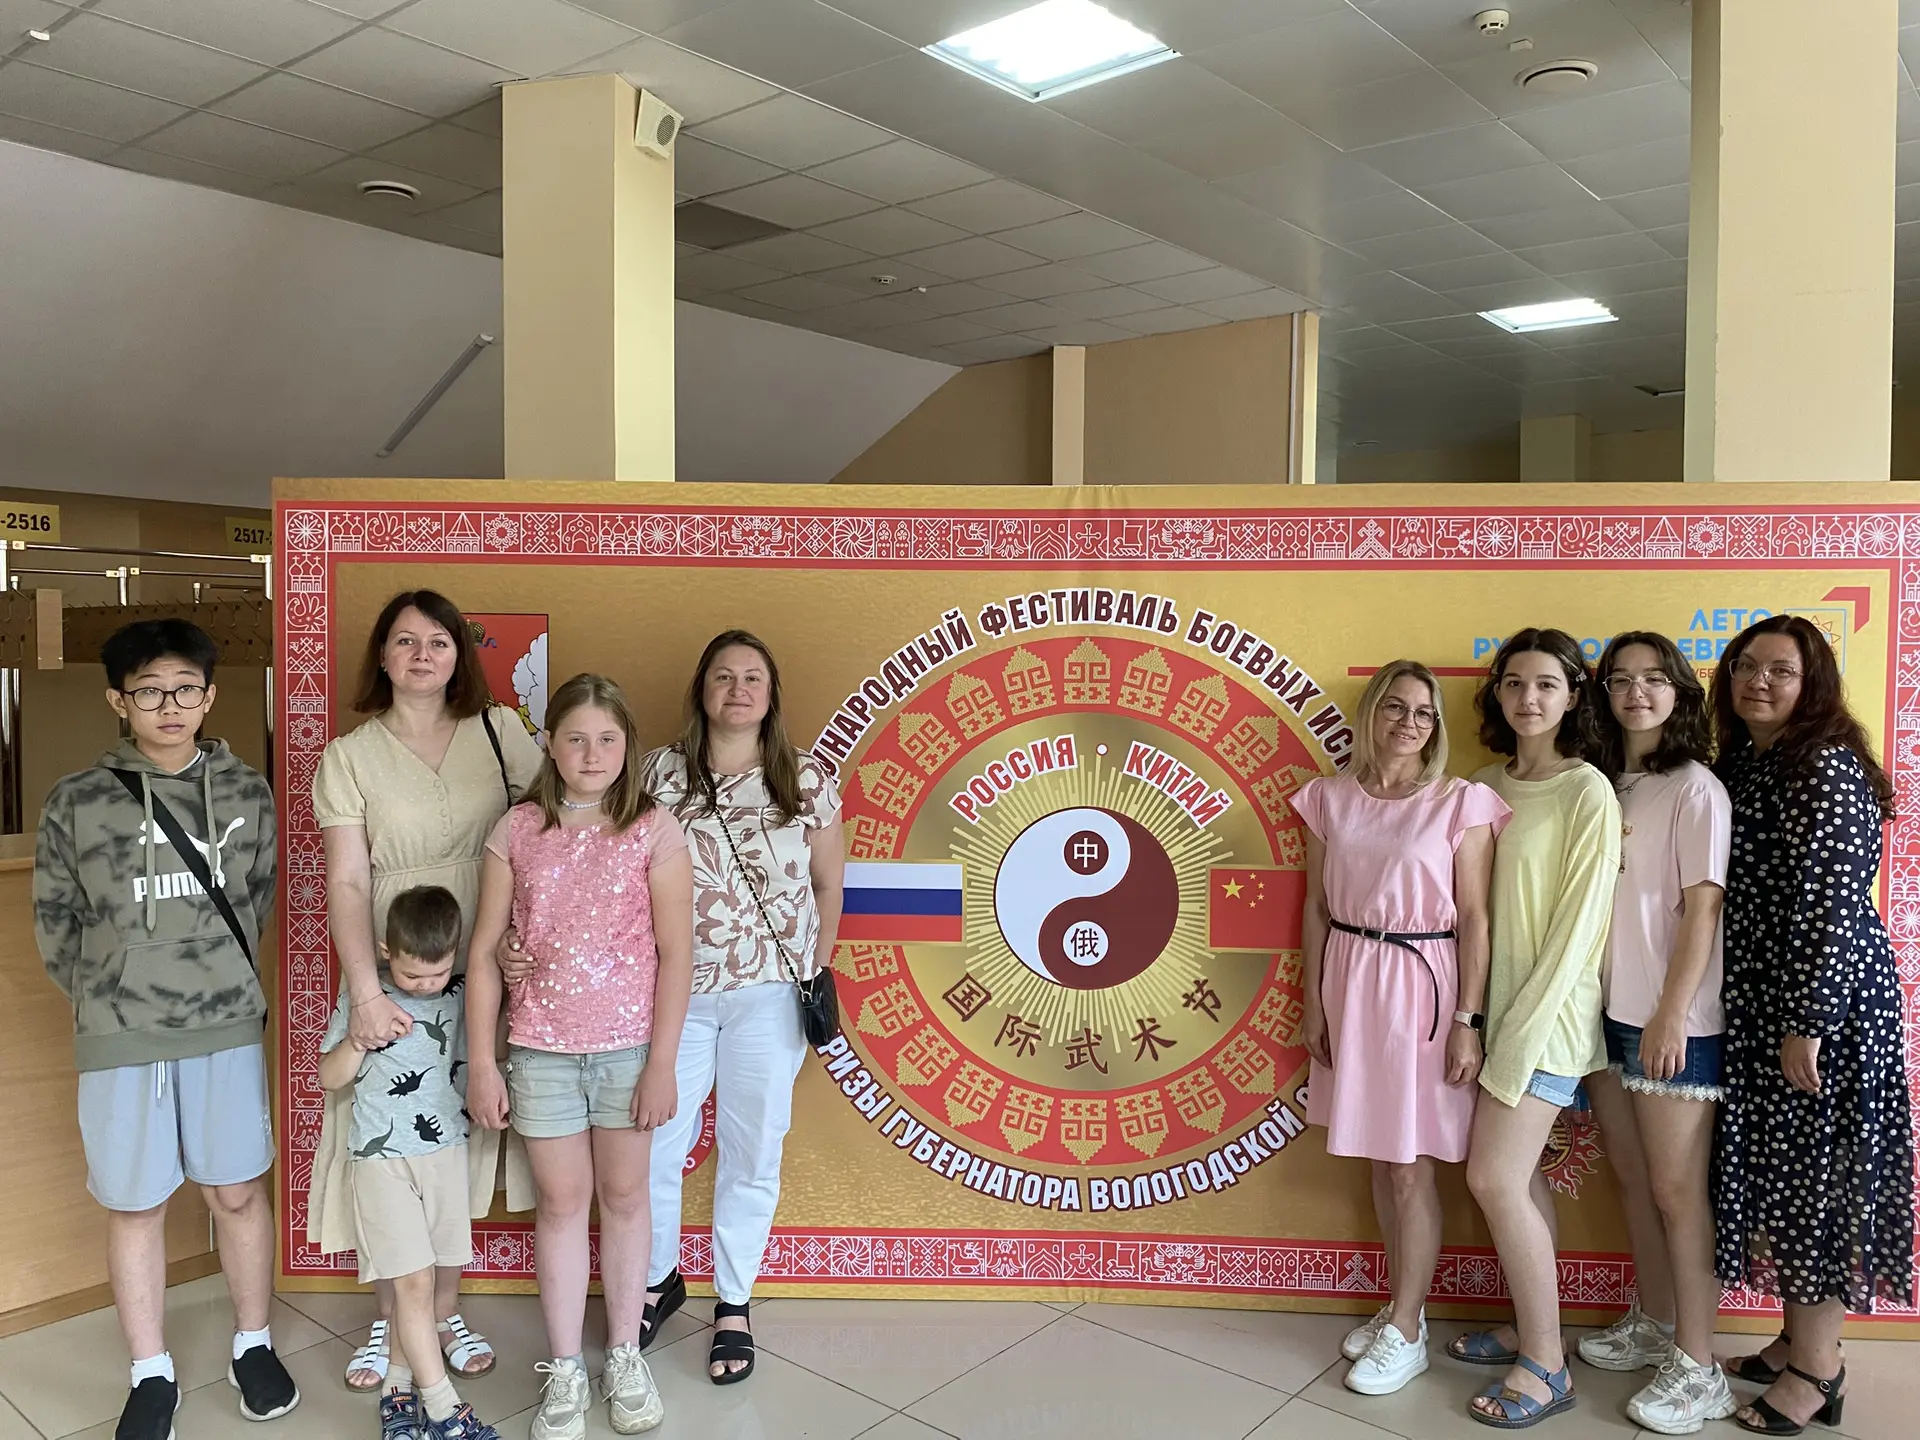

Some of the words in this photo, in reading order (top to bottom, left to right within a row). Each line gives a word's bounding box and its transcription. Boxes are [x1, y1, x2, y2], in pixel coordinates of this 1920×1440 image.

[0, 512, 51, 532] -2516
[811, 607, 977, 788] УНАРОДНЫЙ
[980, 587, 1179, 638] ФЕСТИВАЛЬ
[1186, 607, 1322, 716] БОЕВЫХ
[950, 734, 1078, 825] РОССИЯ
[1124, 740, 1233, 828] КИТАЙ
[1072, 837, 1099, 868] 中
[1070, 928, 1099, 958] 俄
[944, 974, 1222, 1075] 国际武术节
[700, 1098, 715, 1149] РАЦИЯ
[815, 1028, 894, 1122] РИЗЫ
[881, 1106, 1080, 1212] ГУБЕРНАТОРА
[1090, 1098, 1307, 1212] ВОЛОГОДСКОЙ
